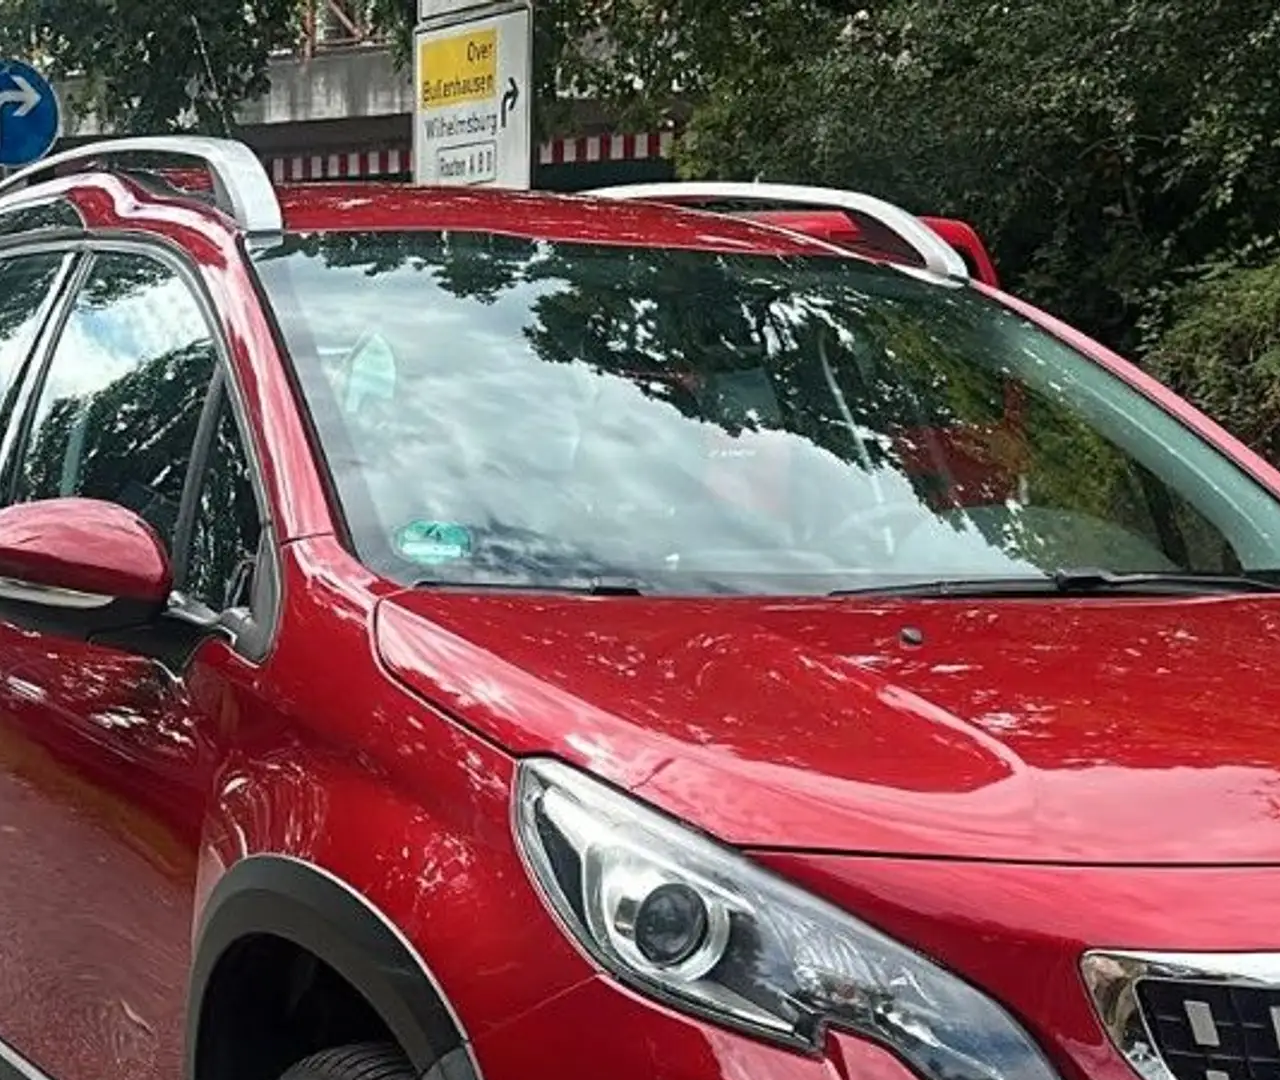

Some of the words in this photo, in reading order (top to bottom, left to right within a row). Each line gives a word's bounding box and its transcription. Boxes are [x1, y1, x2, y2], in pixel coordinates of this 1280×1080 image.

[466, 40, 493, 62] Over
[423, 73, 494, 102] Bullenhausen
[424, 111, 497, 140] Wilhelmsburg
